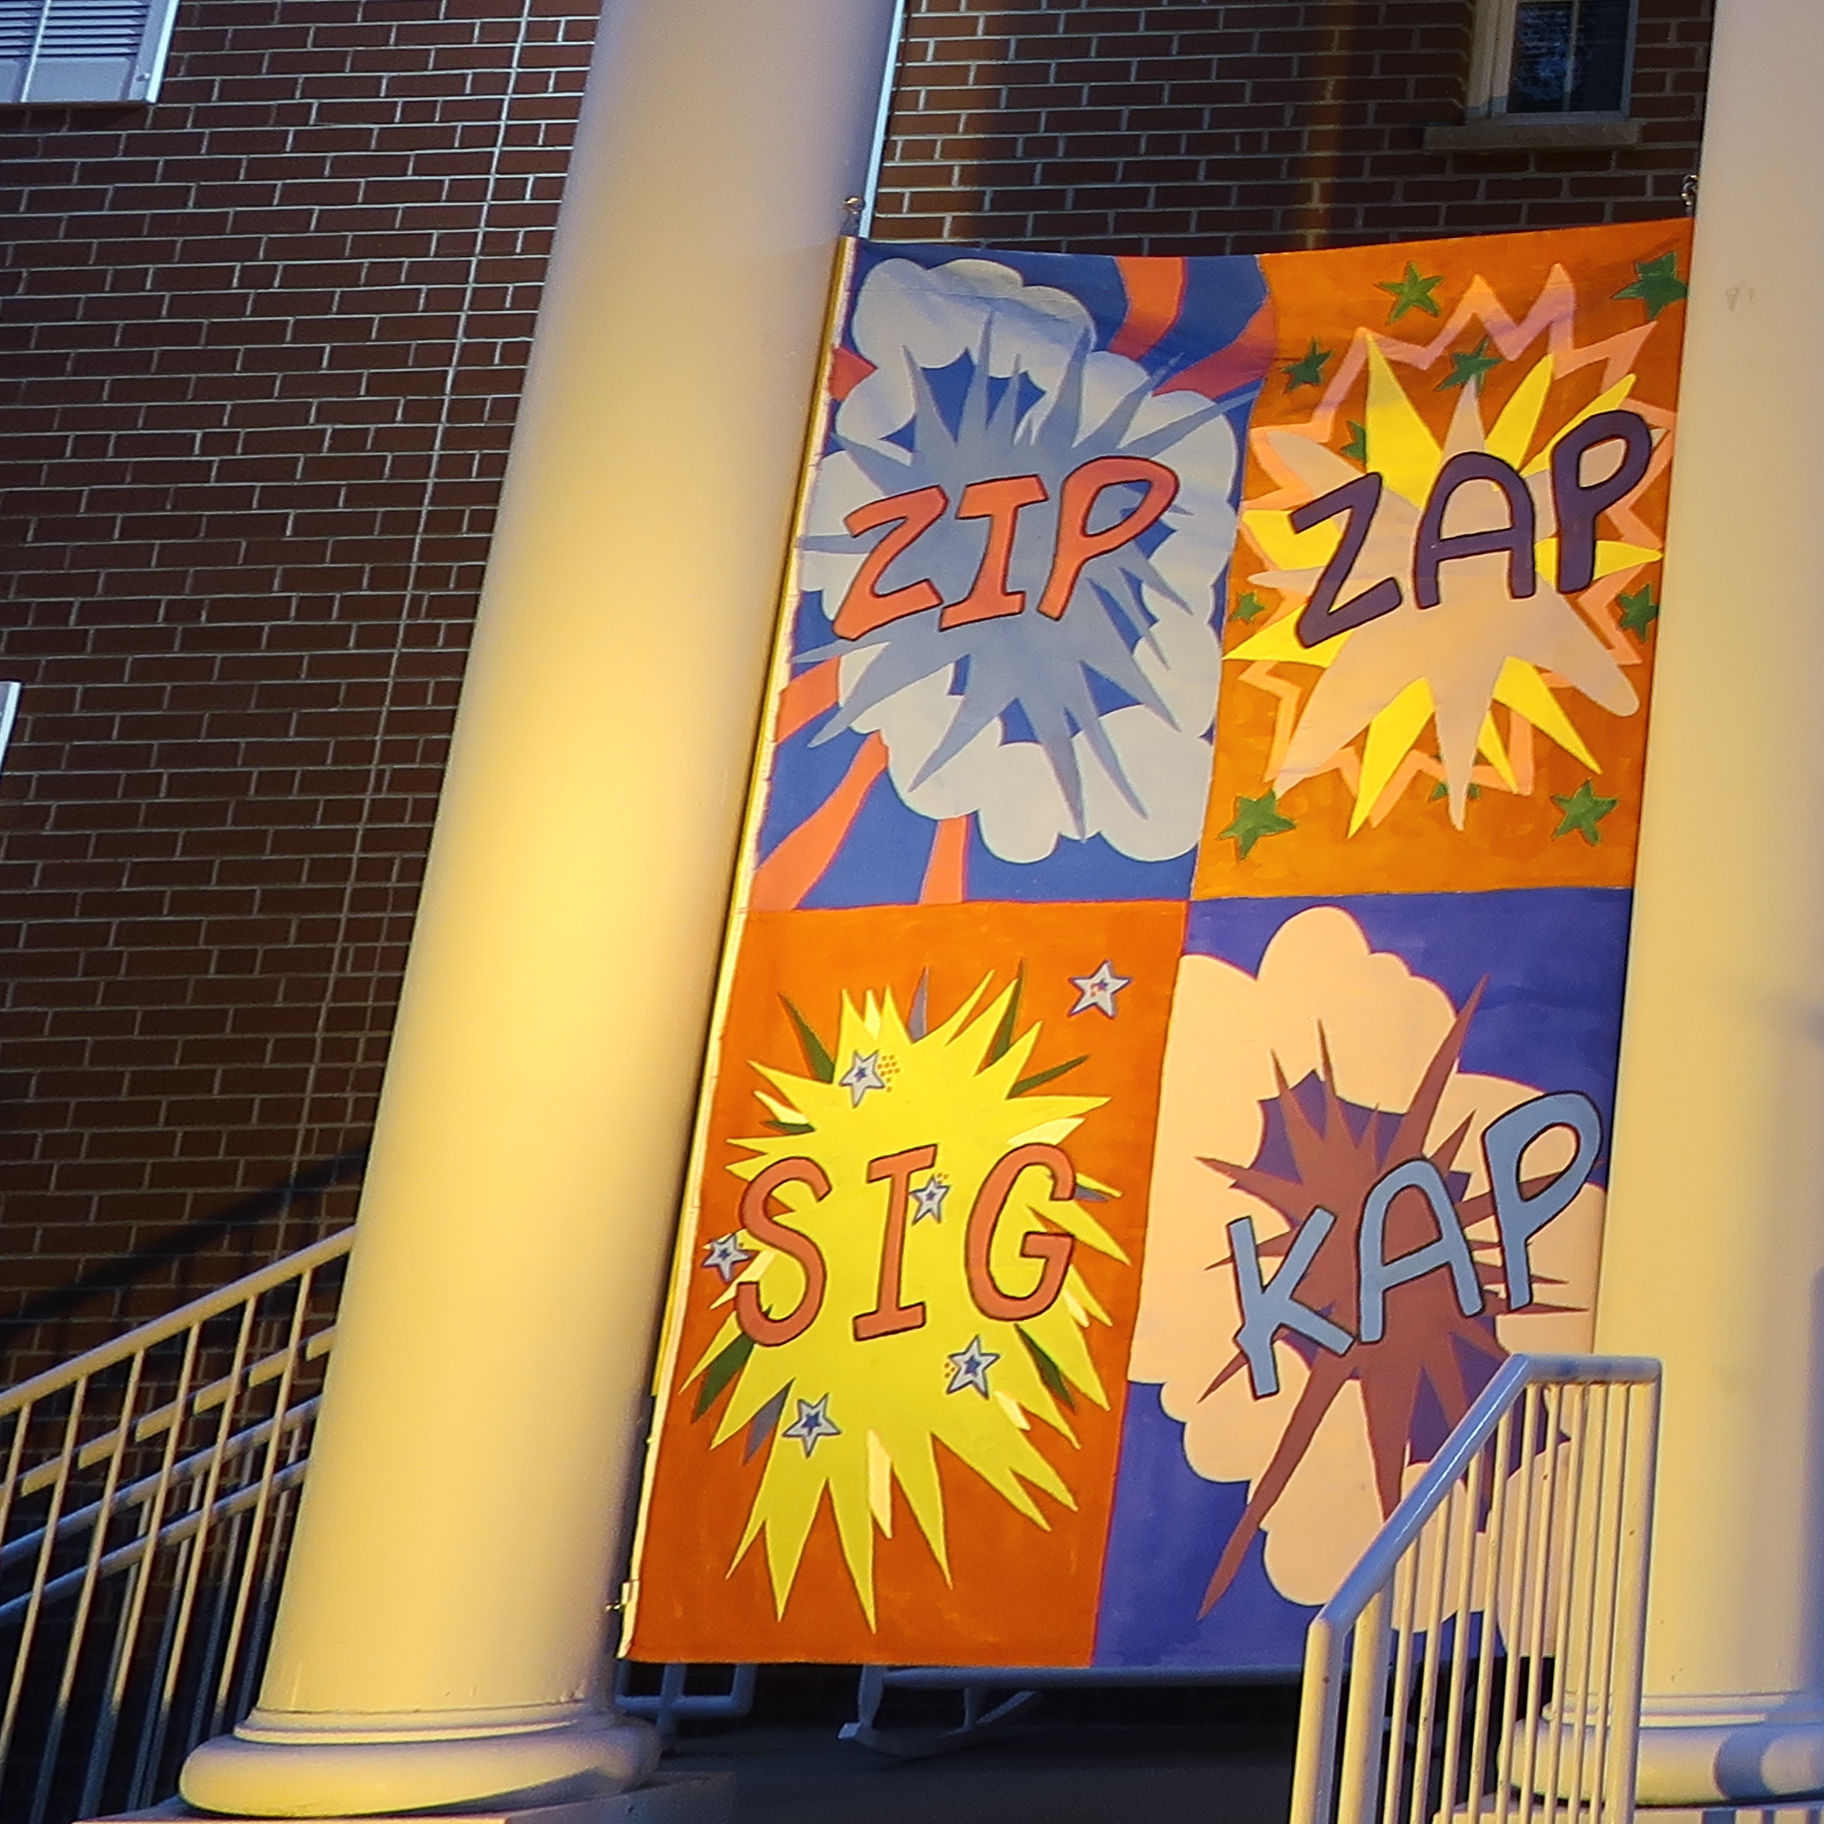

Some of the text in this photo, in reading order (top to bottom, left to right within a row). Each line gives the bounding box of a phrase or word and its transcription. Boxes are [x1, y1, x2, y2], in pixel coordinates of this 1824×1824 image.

[832, 455, 1180, 641] ZIP
[1288, 409, 1653, 649] ZAP
[735, 1143, 1076, 1347] SIG
[1226, 1090, 1601, 1401] KAP
